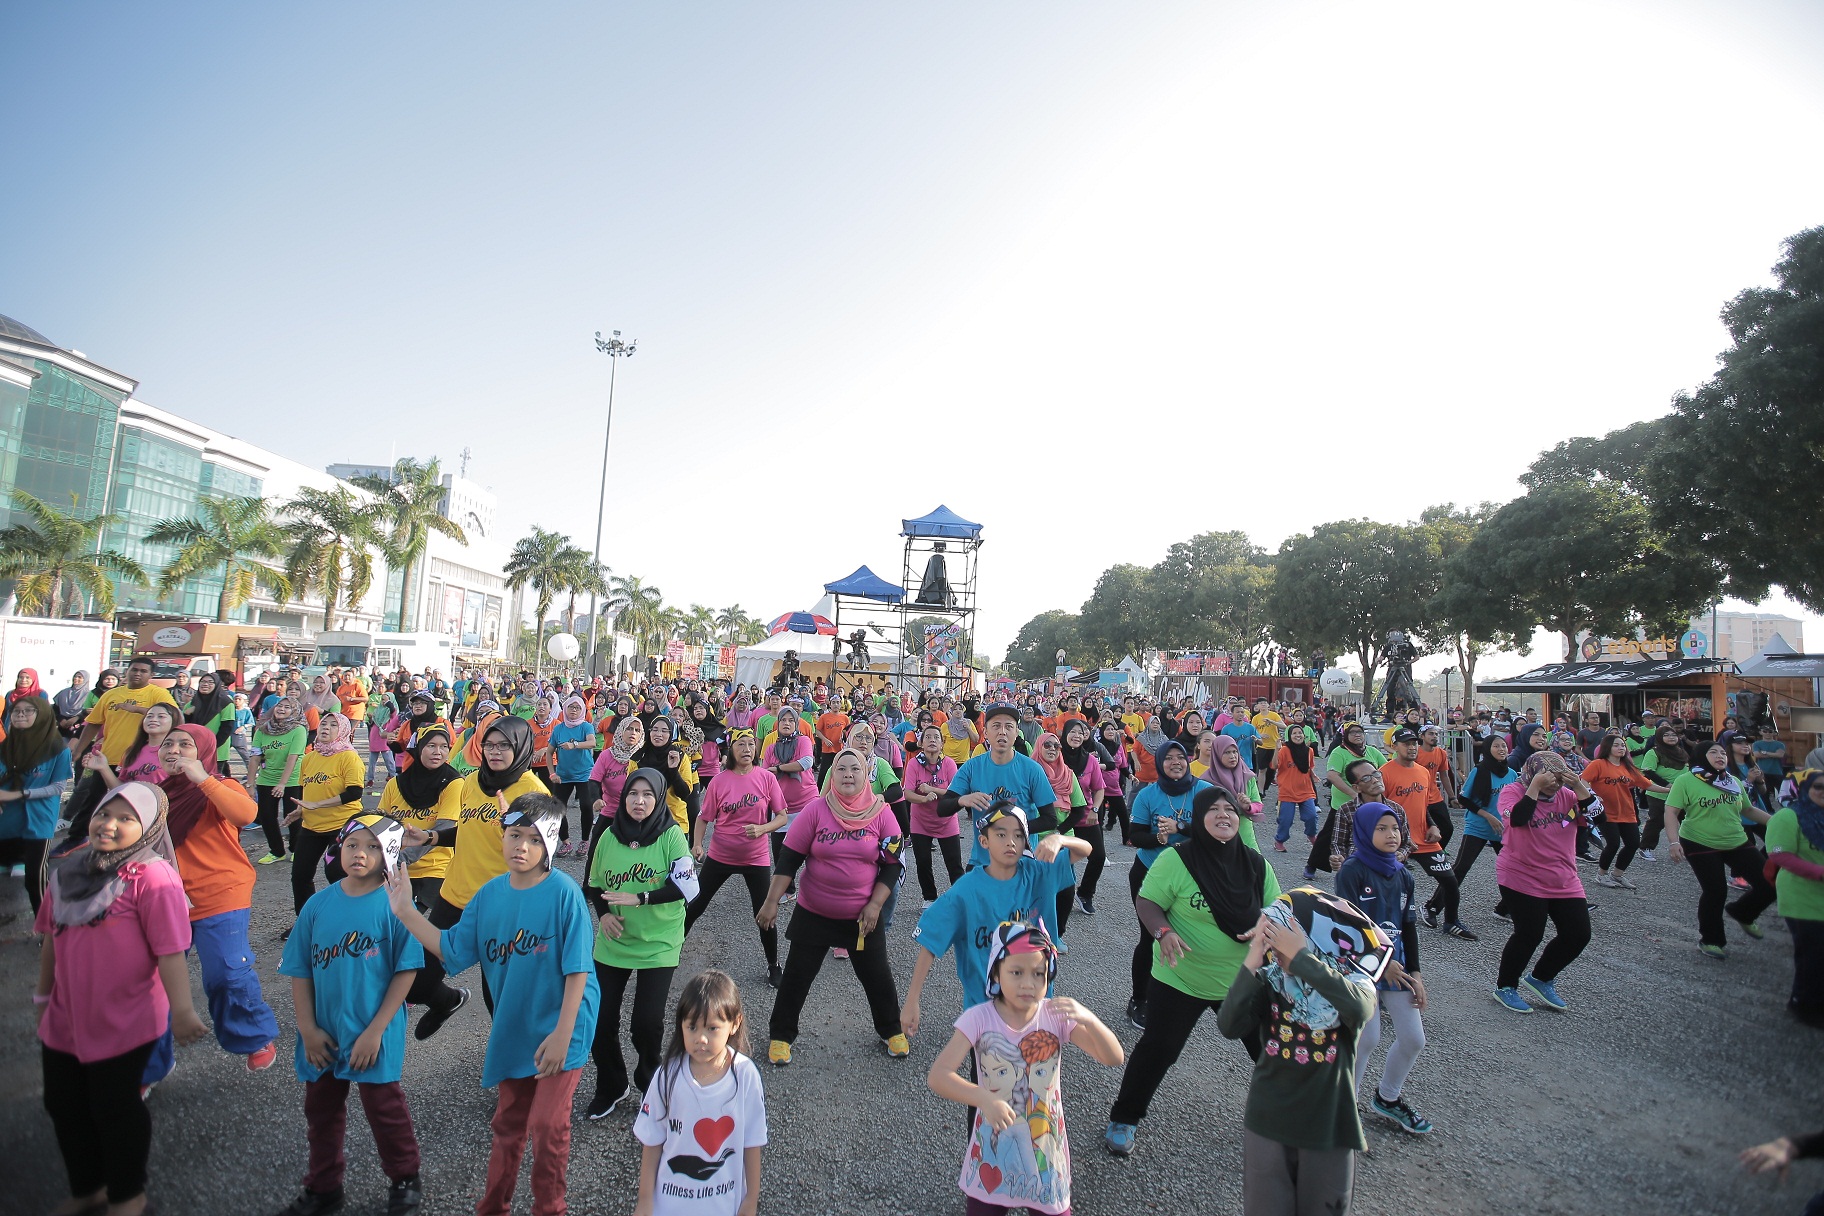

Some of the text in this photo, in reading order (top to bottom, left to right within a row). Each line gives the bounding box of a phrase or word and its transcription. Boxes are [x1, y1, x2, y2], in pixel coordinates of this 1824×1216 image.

[20, 636, 46, 646] Dapu
[1607, 634, 1677, 657] eSports
[721, 793, 766, 815] GegaRia
[605, 863, 667, 890] GegaRia
[1430, 862, 1453, 872] adid
[312, 930, 388, 970] GegaRia
[669, 1118, 683, 1135] We
[662, 1182, 695, 1199] Fitness
[697, 1184, 714, 1199] Life
